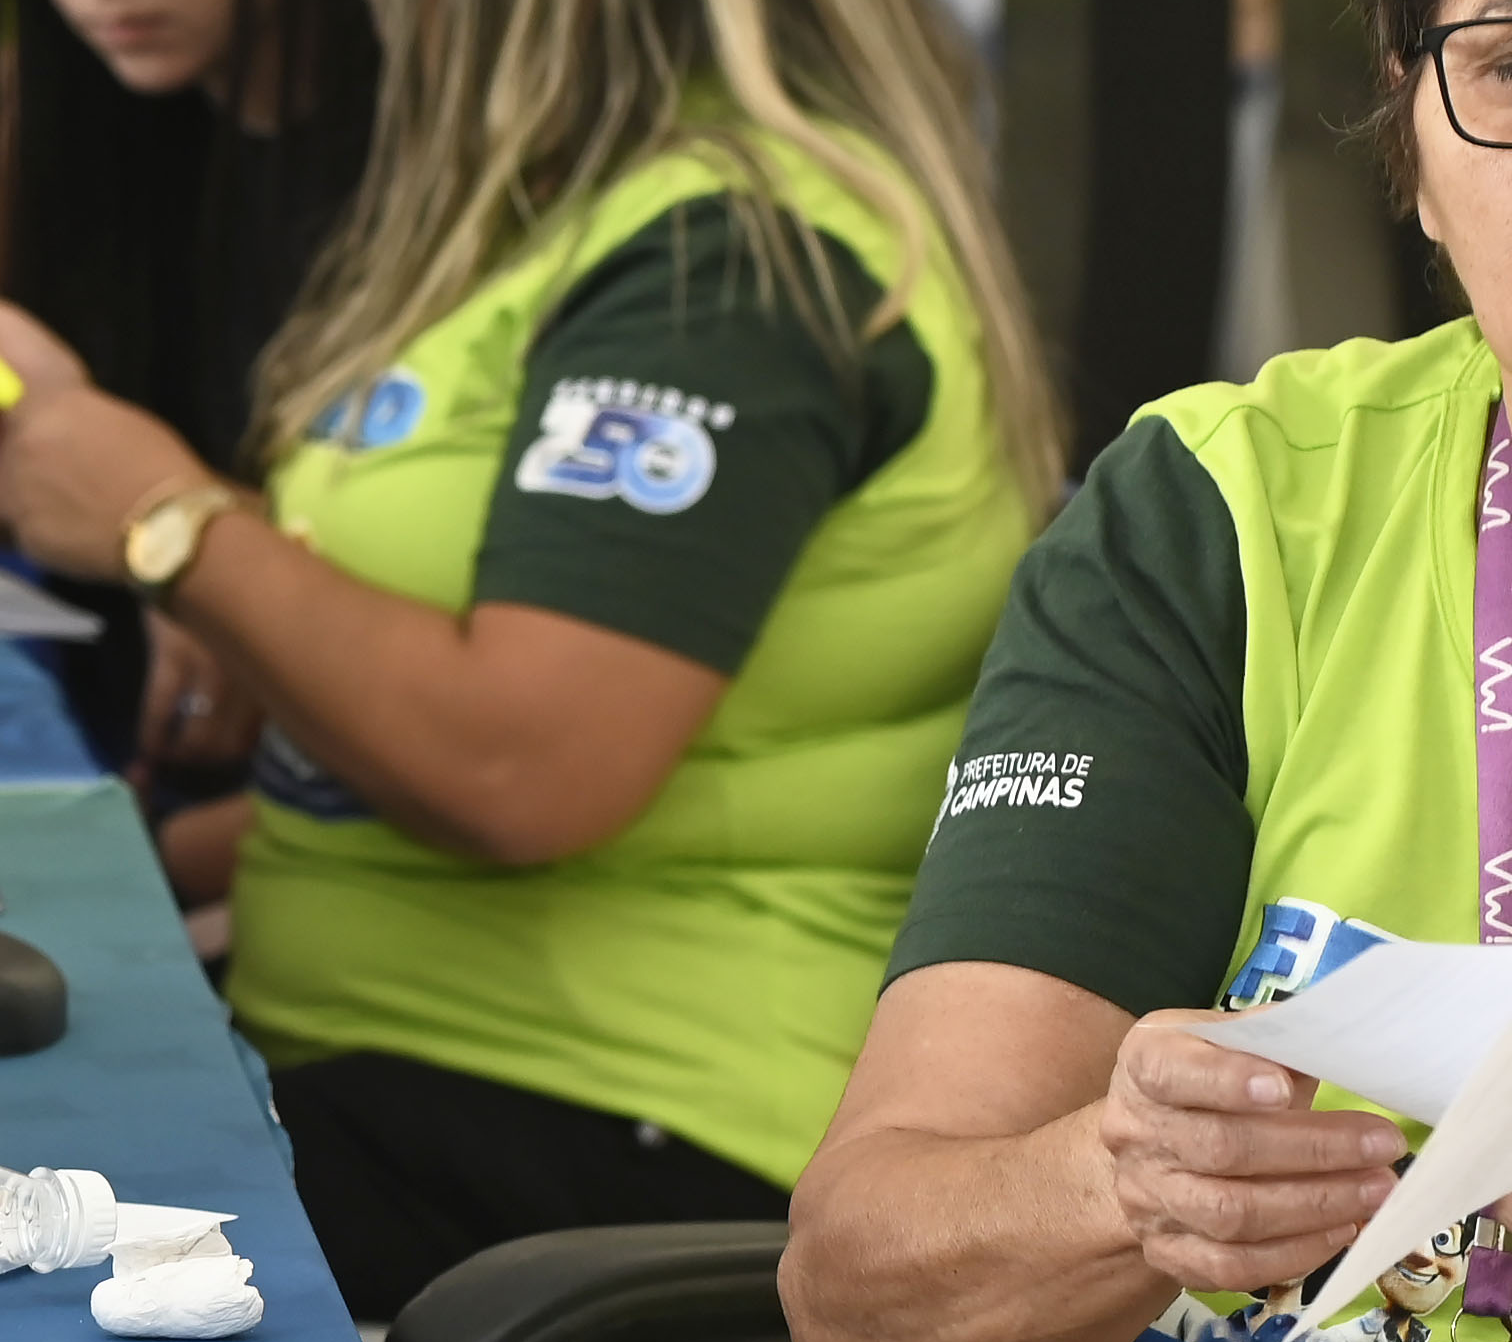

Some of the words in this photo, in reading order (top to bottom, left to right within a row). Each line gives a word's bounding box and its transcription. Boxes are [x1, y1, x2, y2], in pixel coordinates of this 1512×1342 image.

[960, 751, 1056, 785] PREFEITURA
[1060, 752, 1094, 777] DE
[949, 774, 1086, 818] CAMPINAS
